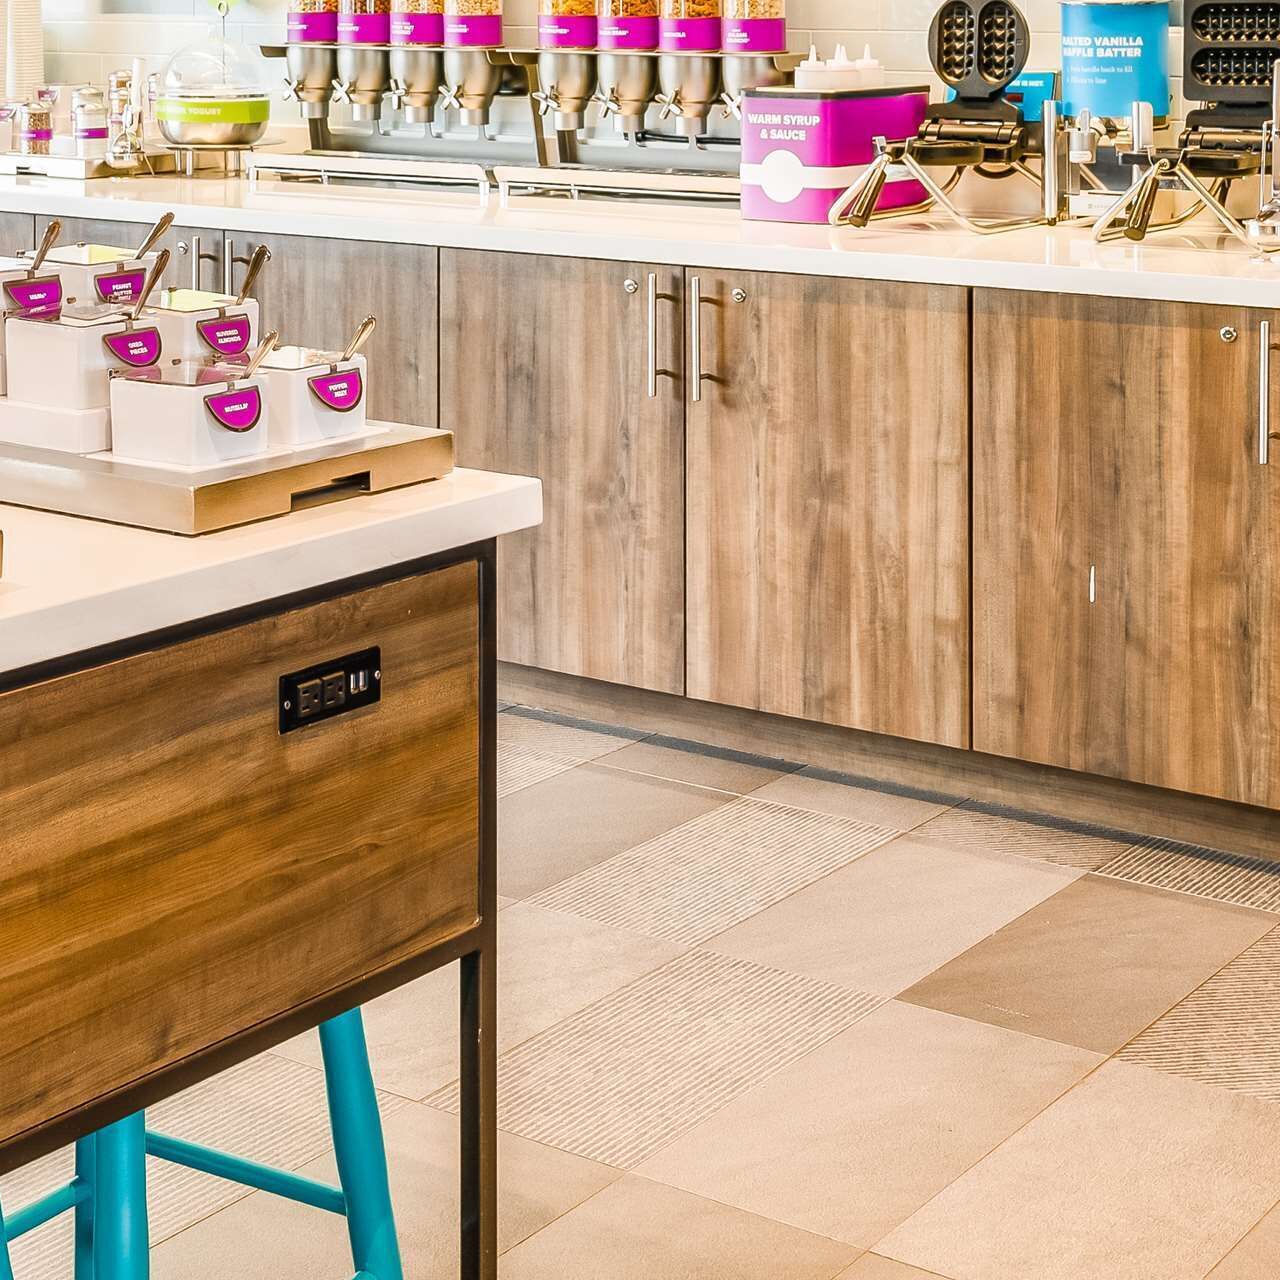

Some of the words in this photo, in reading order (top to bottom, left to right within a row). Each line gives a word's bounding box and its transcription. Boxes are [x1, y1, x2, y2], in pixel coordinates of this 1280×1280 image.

[1094, 36, 1144, 47] VANILLA
[1096, 47, 1142, 57] BATTER
[748, 113, 782, 126] WARM
[783, 113, 821, 126] SYRUP
[760, 128, 769, 140] &
[770, 129, 807, 141] SAUCE
